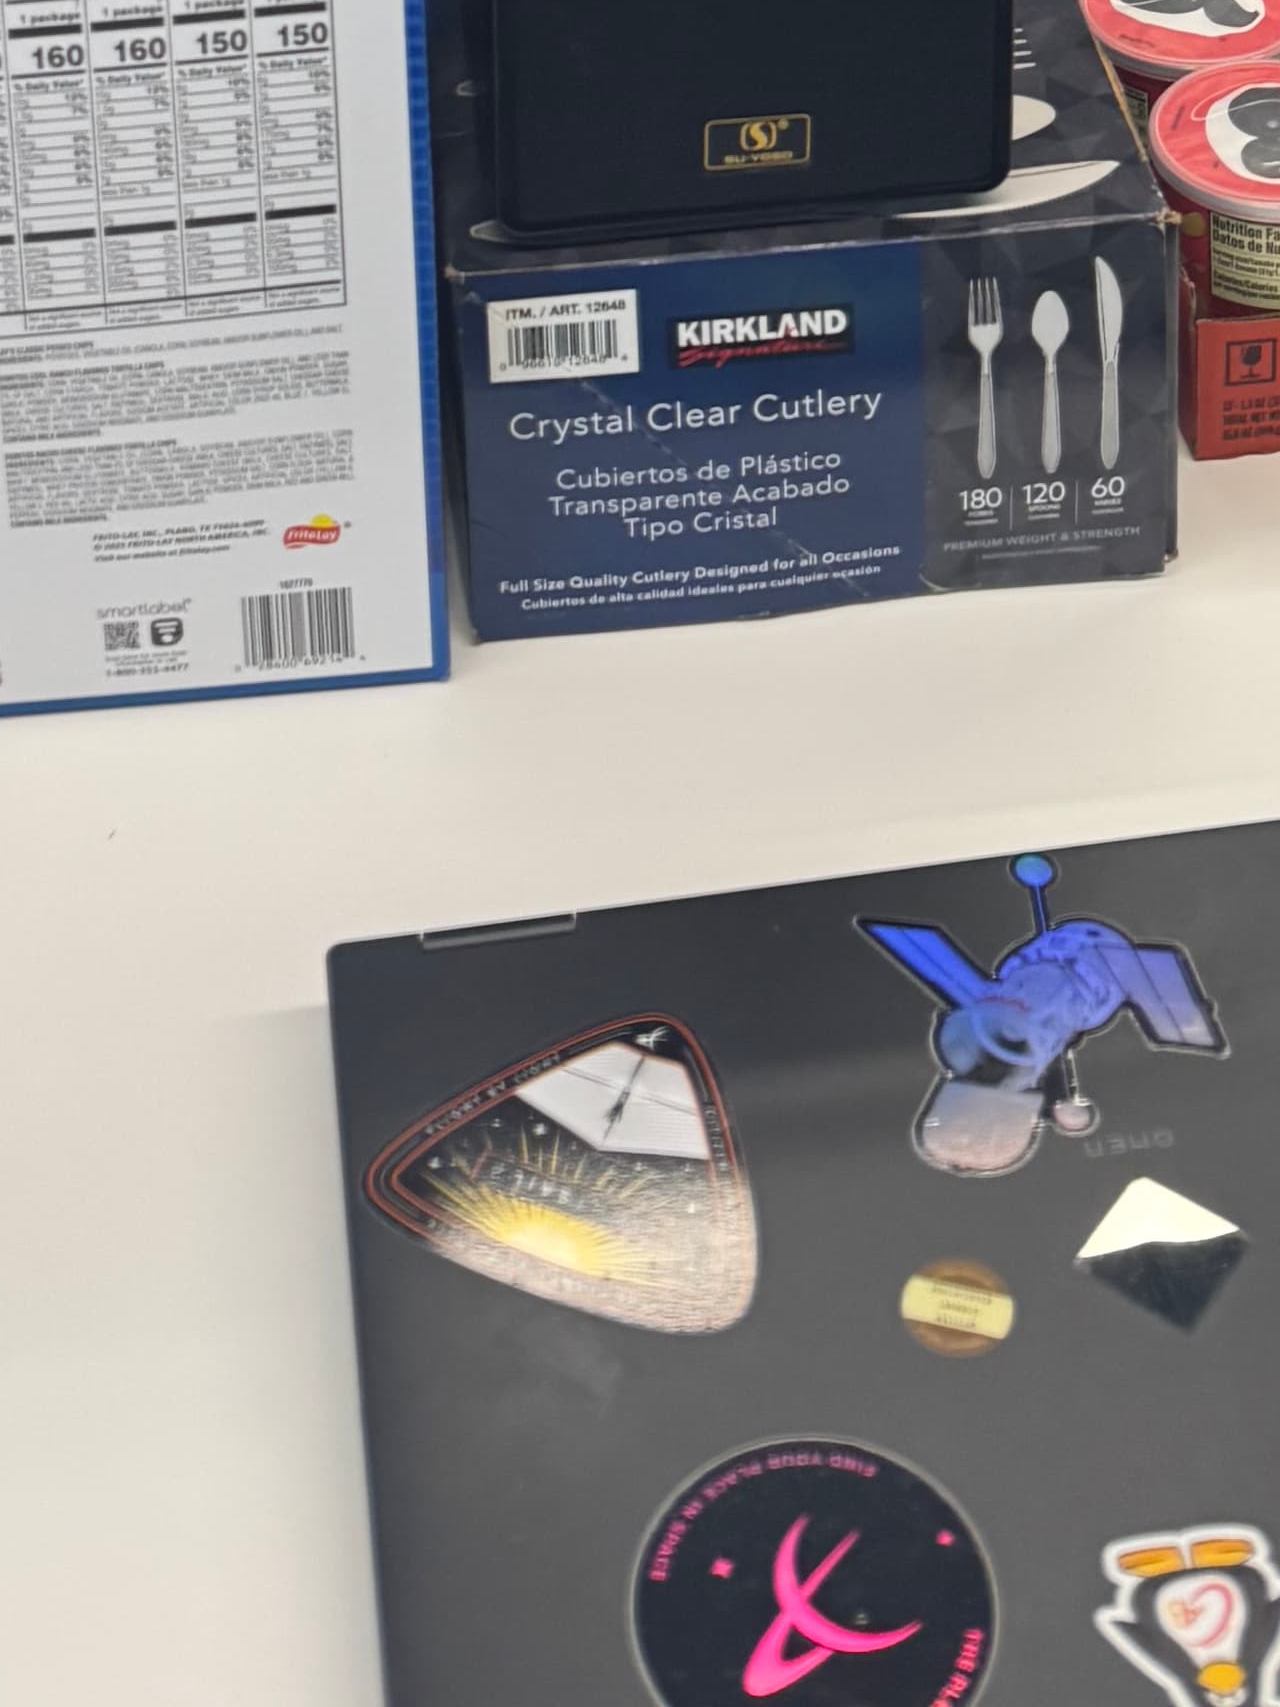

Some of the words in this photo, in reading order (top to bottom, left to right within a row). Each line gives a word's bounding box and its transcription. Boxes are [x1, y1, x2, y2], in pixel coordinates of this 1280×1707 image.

[196, 30, 248, 56] 150
[277, 23, 328, 49] 150
[31, 44, 84, 71] 160
[113, 37, 167, 63] 160
[1212, 215, 1262, 239] Nutrition
[1212, 231, 1245, 249] Datos
[1248, 239, 1263, 252] de
[505, 306, 537, 322] ITM.
[549, 303, 580, 317] ART.
[677, 309, 848, 347] KIRKLAND
[510, 404, 634, 446] Crystal
[647, 401, 742, 432] Clear
[753, 389, 883, 422] Cutlery
[556, 465, 688, 491] Cubiertos
[697, 462, 731, 482] de
[740, 451, 842, 478] Plástico
[547, 488, 723, 518] Transparente
[732, 474, 851, 504] Acabado
[959, 487, 1003, 511] 180
[1022, 481, 1066, 505] 120
[1091, 476, 1126, 498] 60
[624, 512, 684, 542] Tipo
[693, 506, 778, 534] Cristal
[944, 538, 1003, 552] PREMIUM
[1007, 533, 1057, 546] WEIGHT
[1061, 533, 1069, 541] &
[1073, 526, 1140, 541] STRENGTH
[499, 580, 530, 595] Full
[533, 577, 566, 593] Size
[569, 572, 629, 591] Quality
[631, 567, 690, 588] Cutlery
[694, 560, 769, 582] Designed
[772, 555, 796, 572] for
[799, 553, 818, 569] all
[821, 544, 901, 566] Occasions
[521, 595, 587, 611] Cubiertos
[589, 592, 607, 605] de
[609, 590, 634, 604] alta
[636, 586, 685, 601] calidad
[687, 583, 735, 598] ideales
[736, 579, 767, 595] para
[769, 571, 830, 591] cualquier
[831, 564, 882, 580] ocasión
[96, 599, 187, 618] smartlabel
[769, 1452, 821, 1471] YOUR
[829, 1454, 877, 1477] FIND
[703, 1462, 763, 1501] PLACE
[682, 1500, 704, 1520] IN
[649, 1520, 688, 1581] SPACE
[955, 1628, 985, 1673] THE
